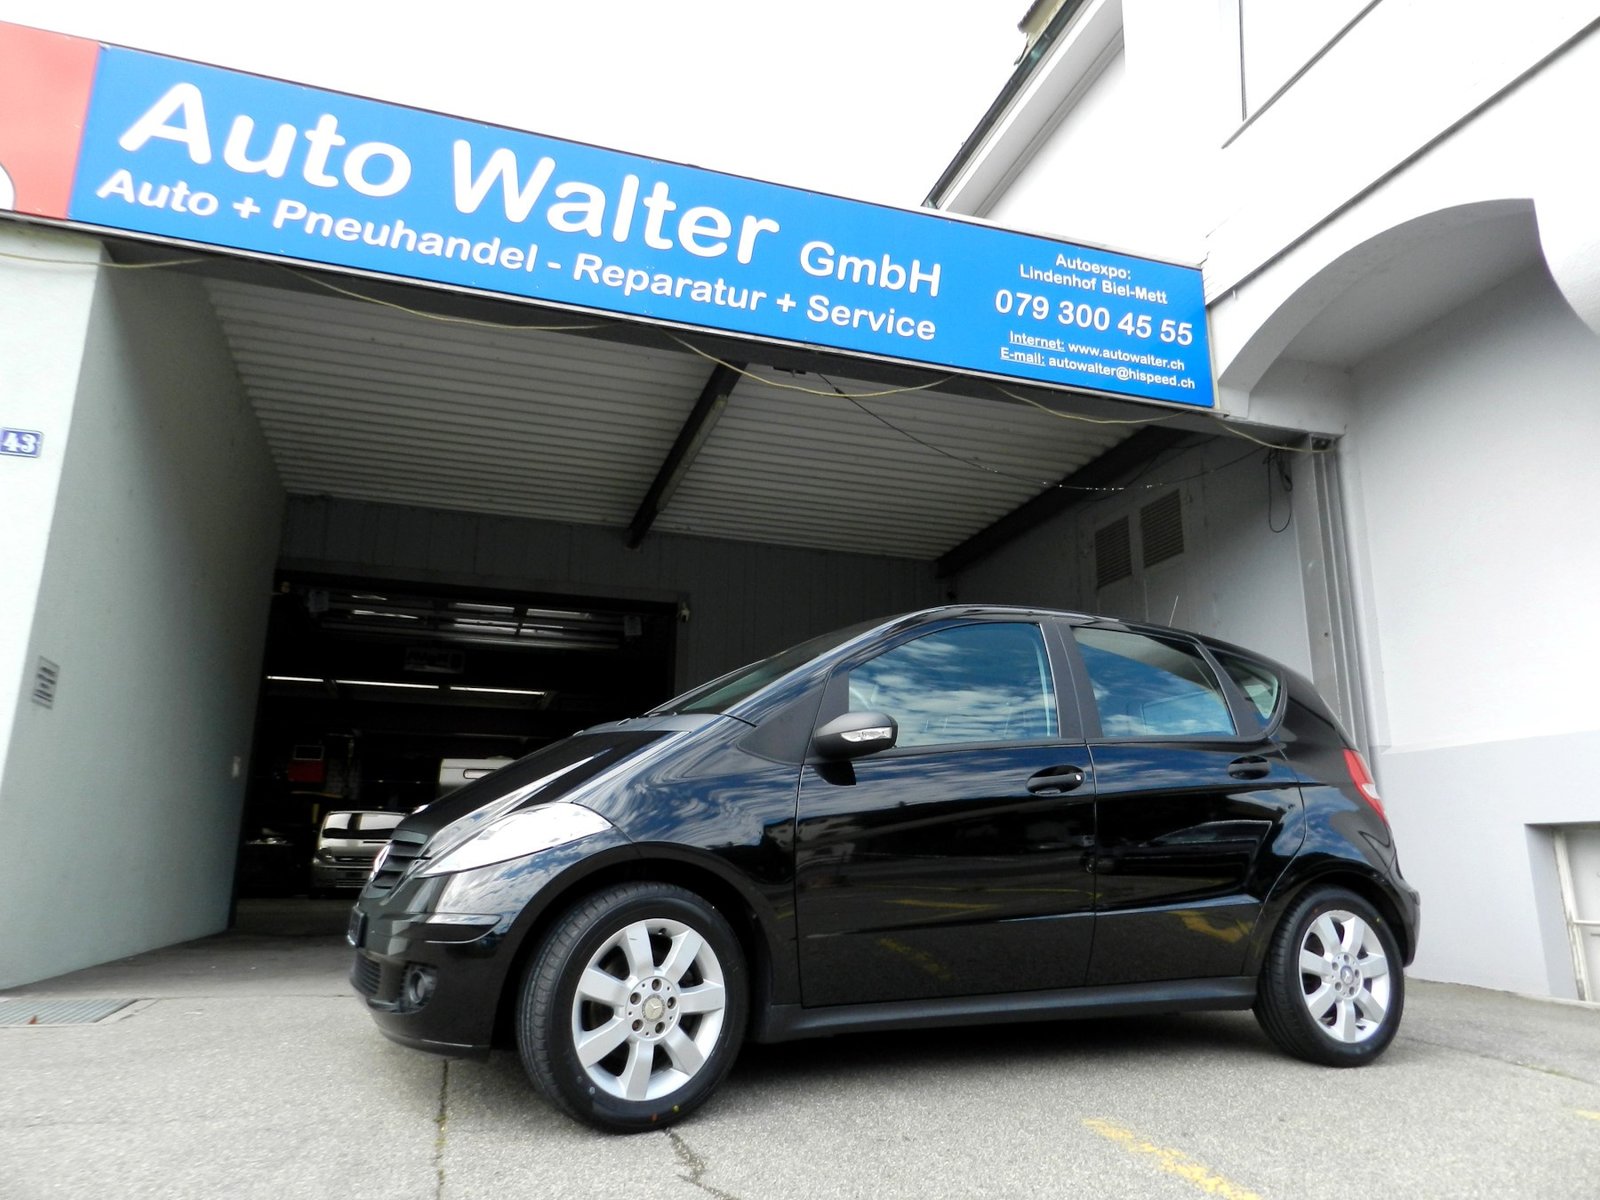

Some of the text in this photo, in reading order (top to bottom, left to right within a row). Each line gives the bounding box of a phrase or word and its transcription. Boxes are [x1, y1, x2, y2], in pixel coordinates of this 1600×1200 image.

[117, 80, 942, 298] Auto Walter GmbH
[95, 168, 220, 218] Auto
[231, 196, 262, 220] +
[271, 198, 539, 273] Pneuhandel
[572, 253, 768, 312] Reparatur
[776, 294, 797, 313] +
[806, 295, 936, 341] Service
[1055, 253, 1131, 280] Autoexpo:
[1019, 264, 1168, 305] Lindenhof Biel-Mett
[995, 289, 1194, 346] 079 300 45 55
[1000, 346, 1196, 389] E-mail: autowalter@hispeed.ch
[1009, 330, 1185, 371] Internet: www.autowalter.ch
[3, 432, 37, 453] 43
